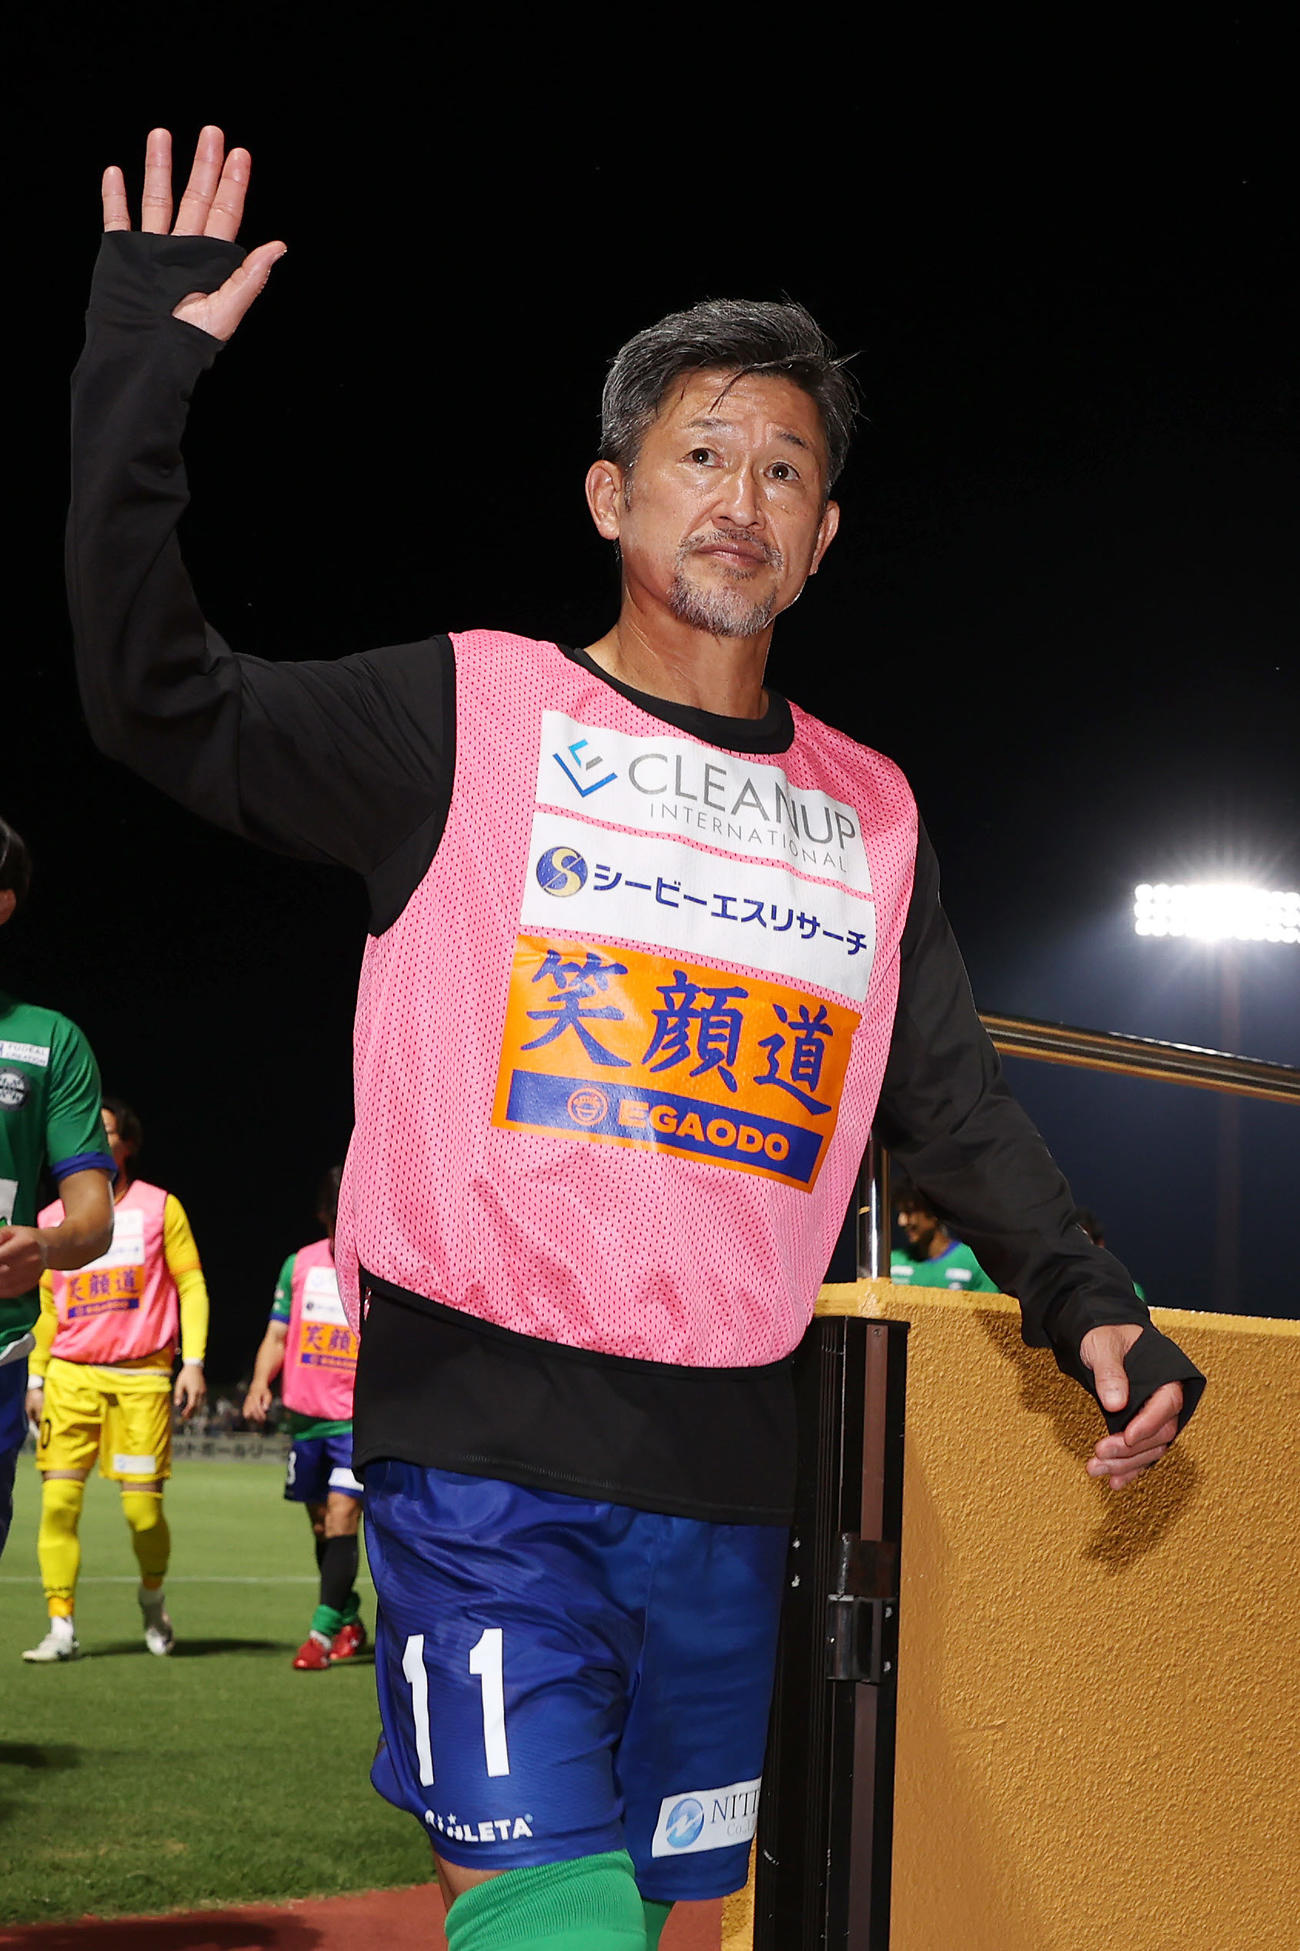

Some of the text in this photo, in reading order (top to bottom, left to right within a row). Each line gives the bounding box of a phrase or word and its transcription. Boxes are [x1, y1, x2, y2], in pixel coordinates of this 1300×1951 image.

[628, 753, 856, 851] CLEANUP
[650, 803, 847, 873] INTERNATIONAL
[593, 863, 868, 956] シービーエスリサーチ
[520, 948, 834, 1116] 笑顔道
[617, 1100, 790, 1161] EGAODO
[306, 1325, 358, 1354] 笑顔
[401, 1627, 510, 1787] 11
